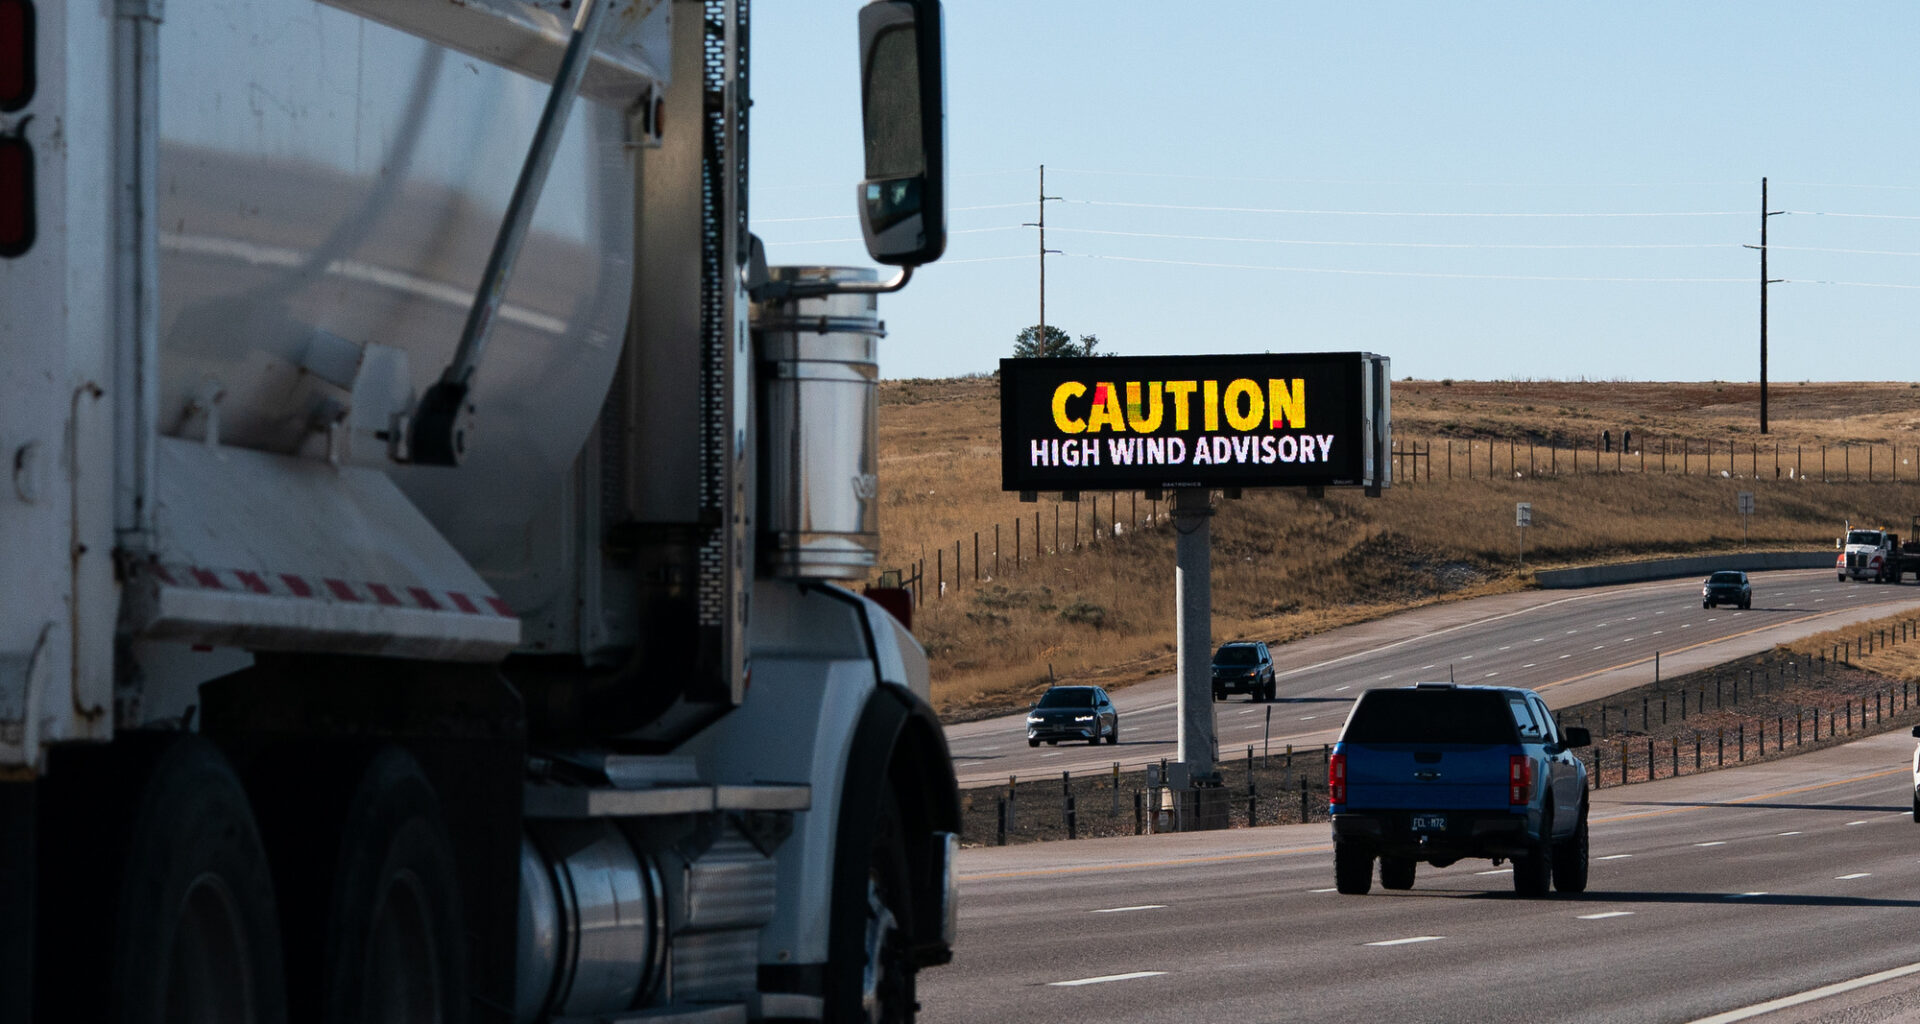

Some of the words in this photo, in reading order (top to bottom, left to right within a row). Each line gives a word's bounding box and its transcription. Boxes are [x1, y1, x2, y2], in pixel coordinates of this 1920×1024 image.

[1052, 379, 1305, 433] CAUTION
[1031, 439, 1099, 466] HIGH
[1108, 437, 1186, 465] WIND
[1193, 435, 1334, 464] ADVISORY
